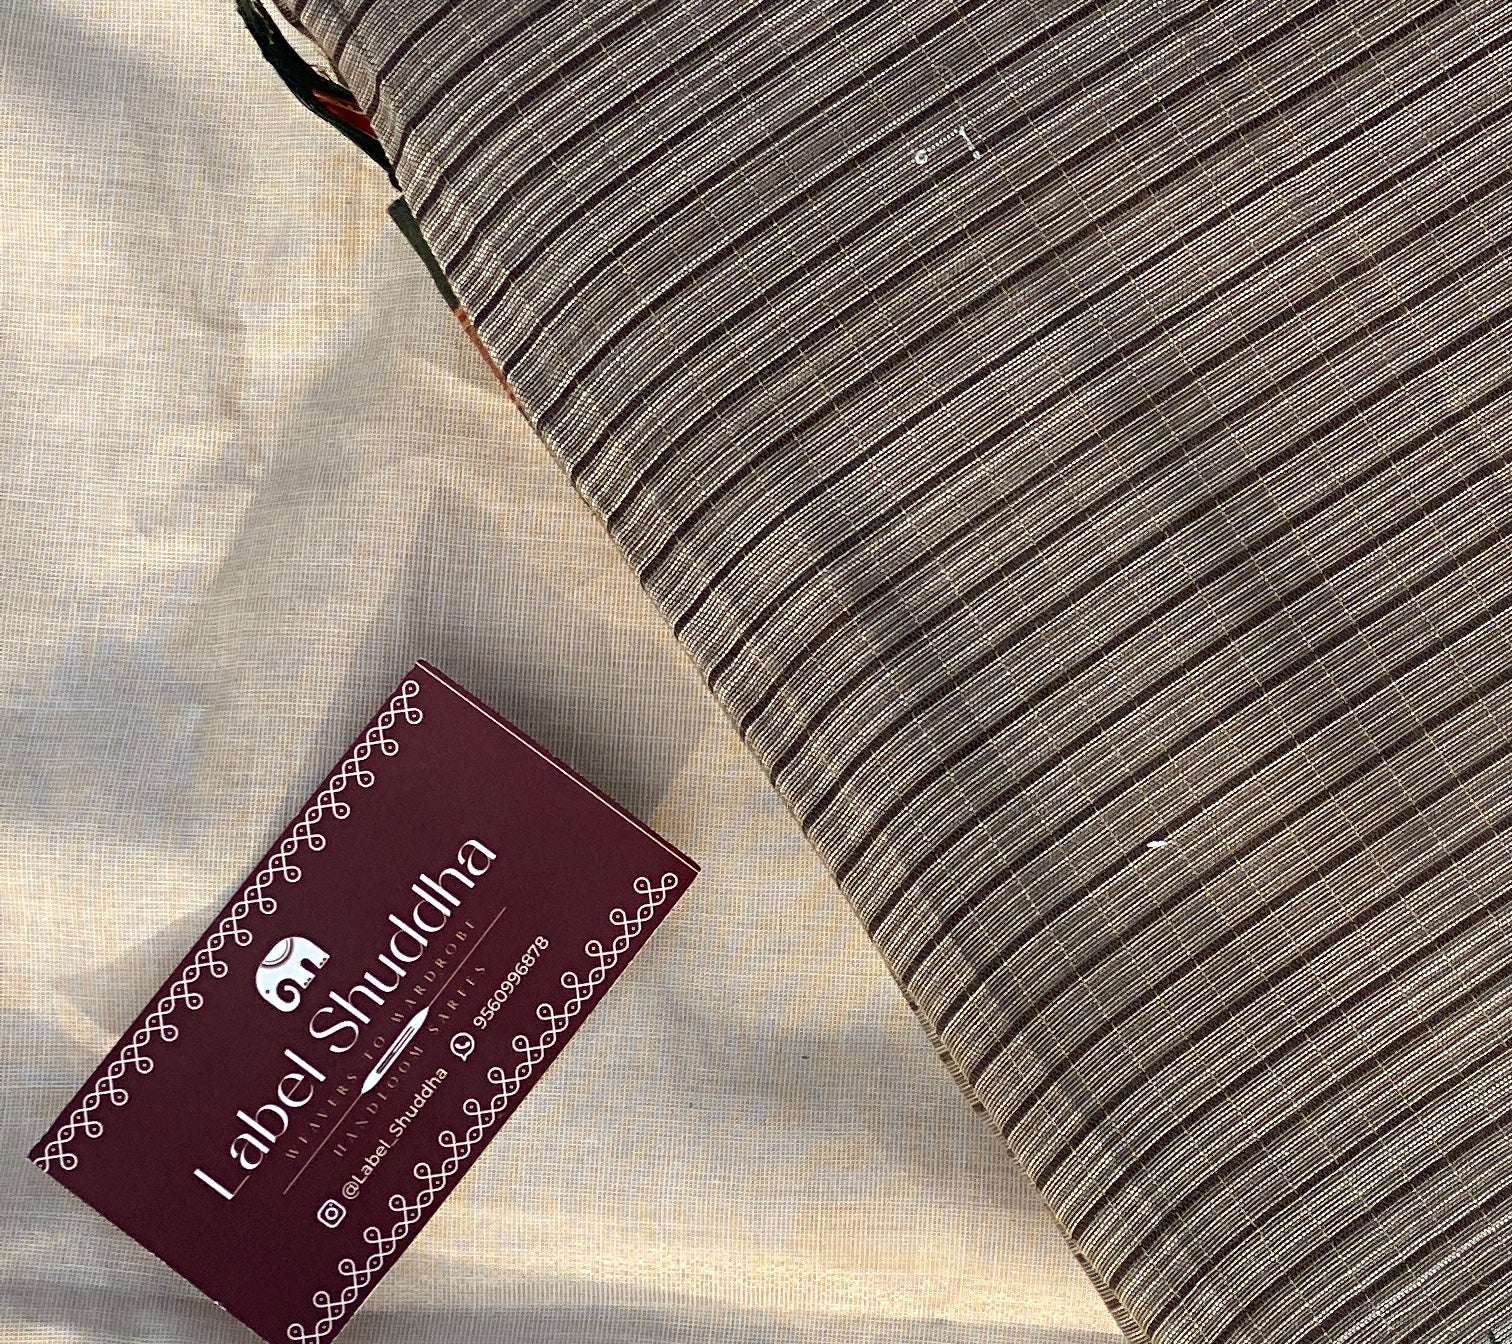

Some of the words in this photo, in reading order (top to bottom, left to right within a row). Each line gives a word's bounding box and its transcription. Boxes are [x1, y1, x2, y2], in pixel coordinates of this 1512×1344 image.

[194, 1048, 326, 1200] Label
[309, 839, 497, 1053] Shuddha
[285, 1072, 358, 1160] WEAVERS
[362, 1035, 386, 1061] TO
[391, 919, 476, 1024] WARDROBE
[472, 935, 550, 1030] 9560996878
[333, 1044, 425, 1158] HANDLOOM
[342, 1066, 449, 1200] @Label_Shuddha
